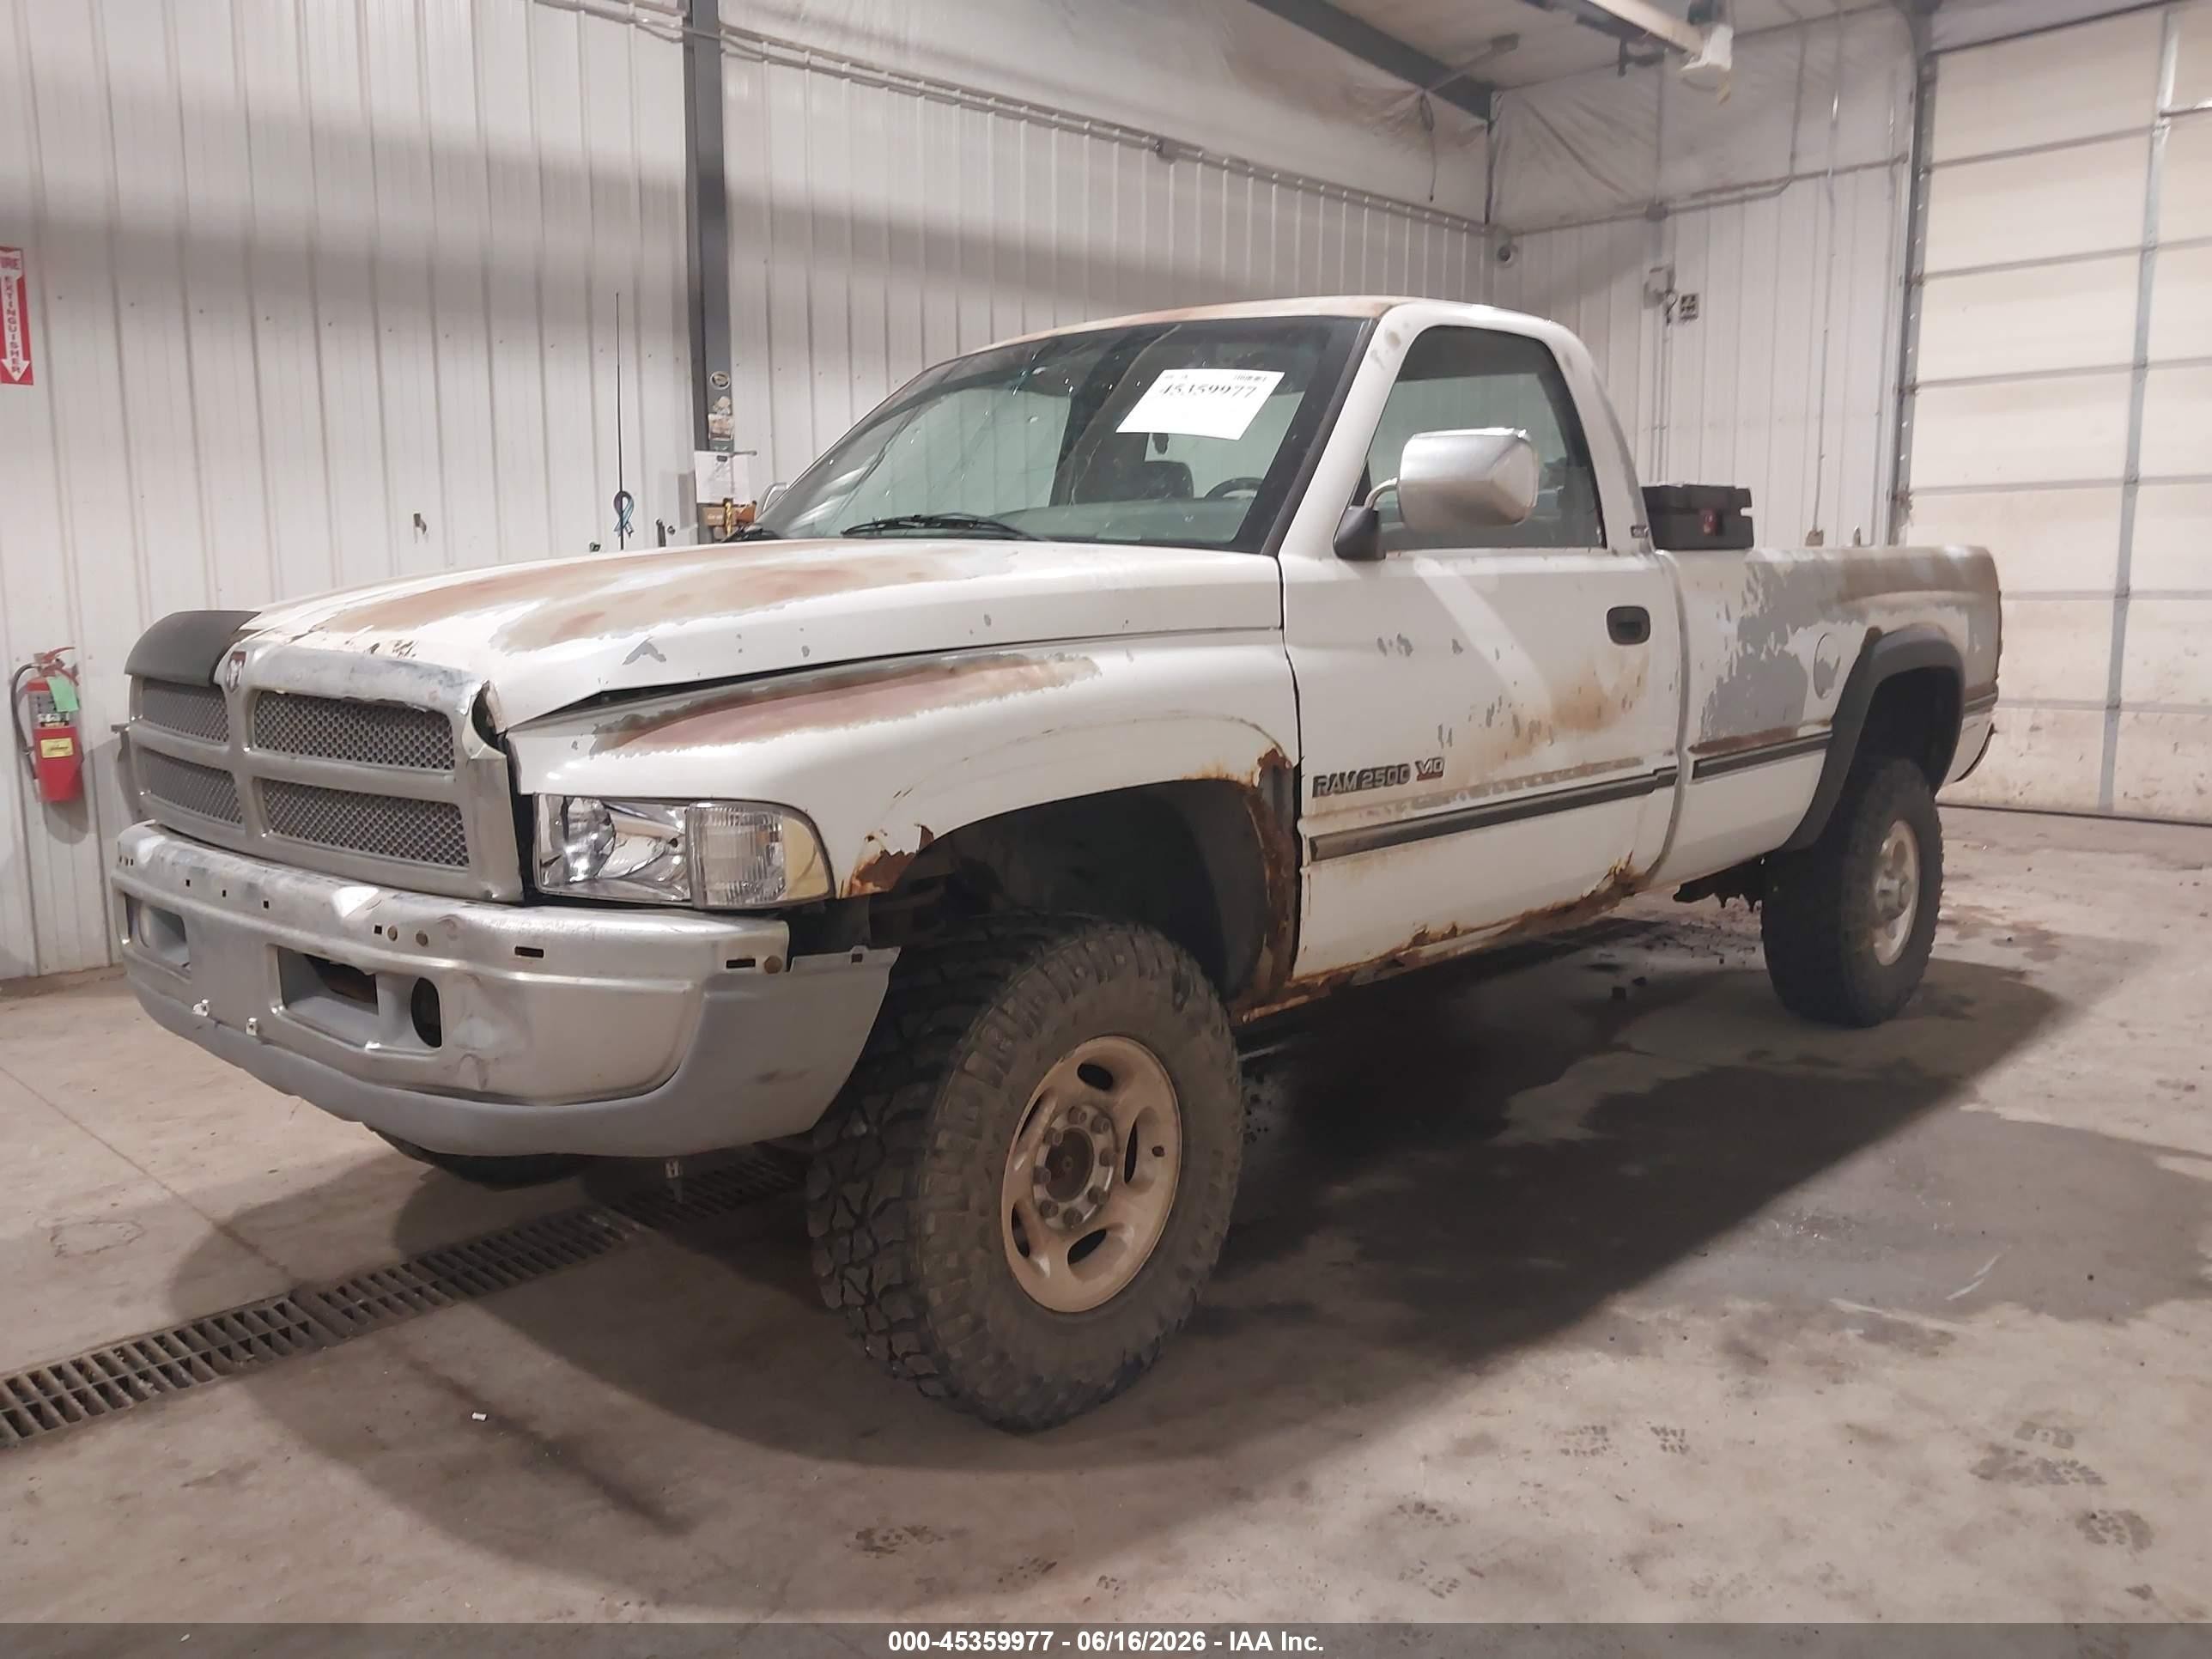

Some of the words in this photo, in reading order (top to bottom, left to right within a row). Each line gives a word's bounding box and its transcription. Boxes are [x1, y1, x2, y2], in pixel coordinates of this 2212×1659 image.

[1312, 770, 1358, 798] RAM
[1357, 763, 1411, 789] 2500
[1415, 757, 1445, 781] V10
